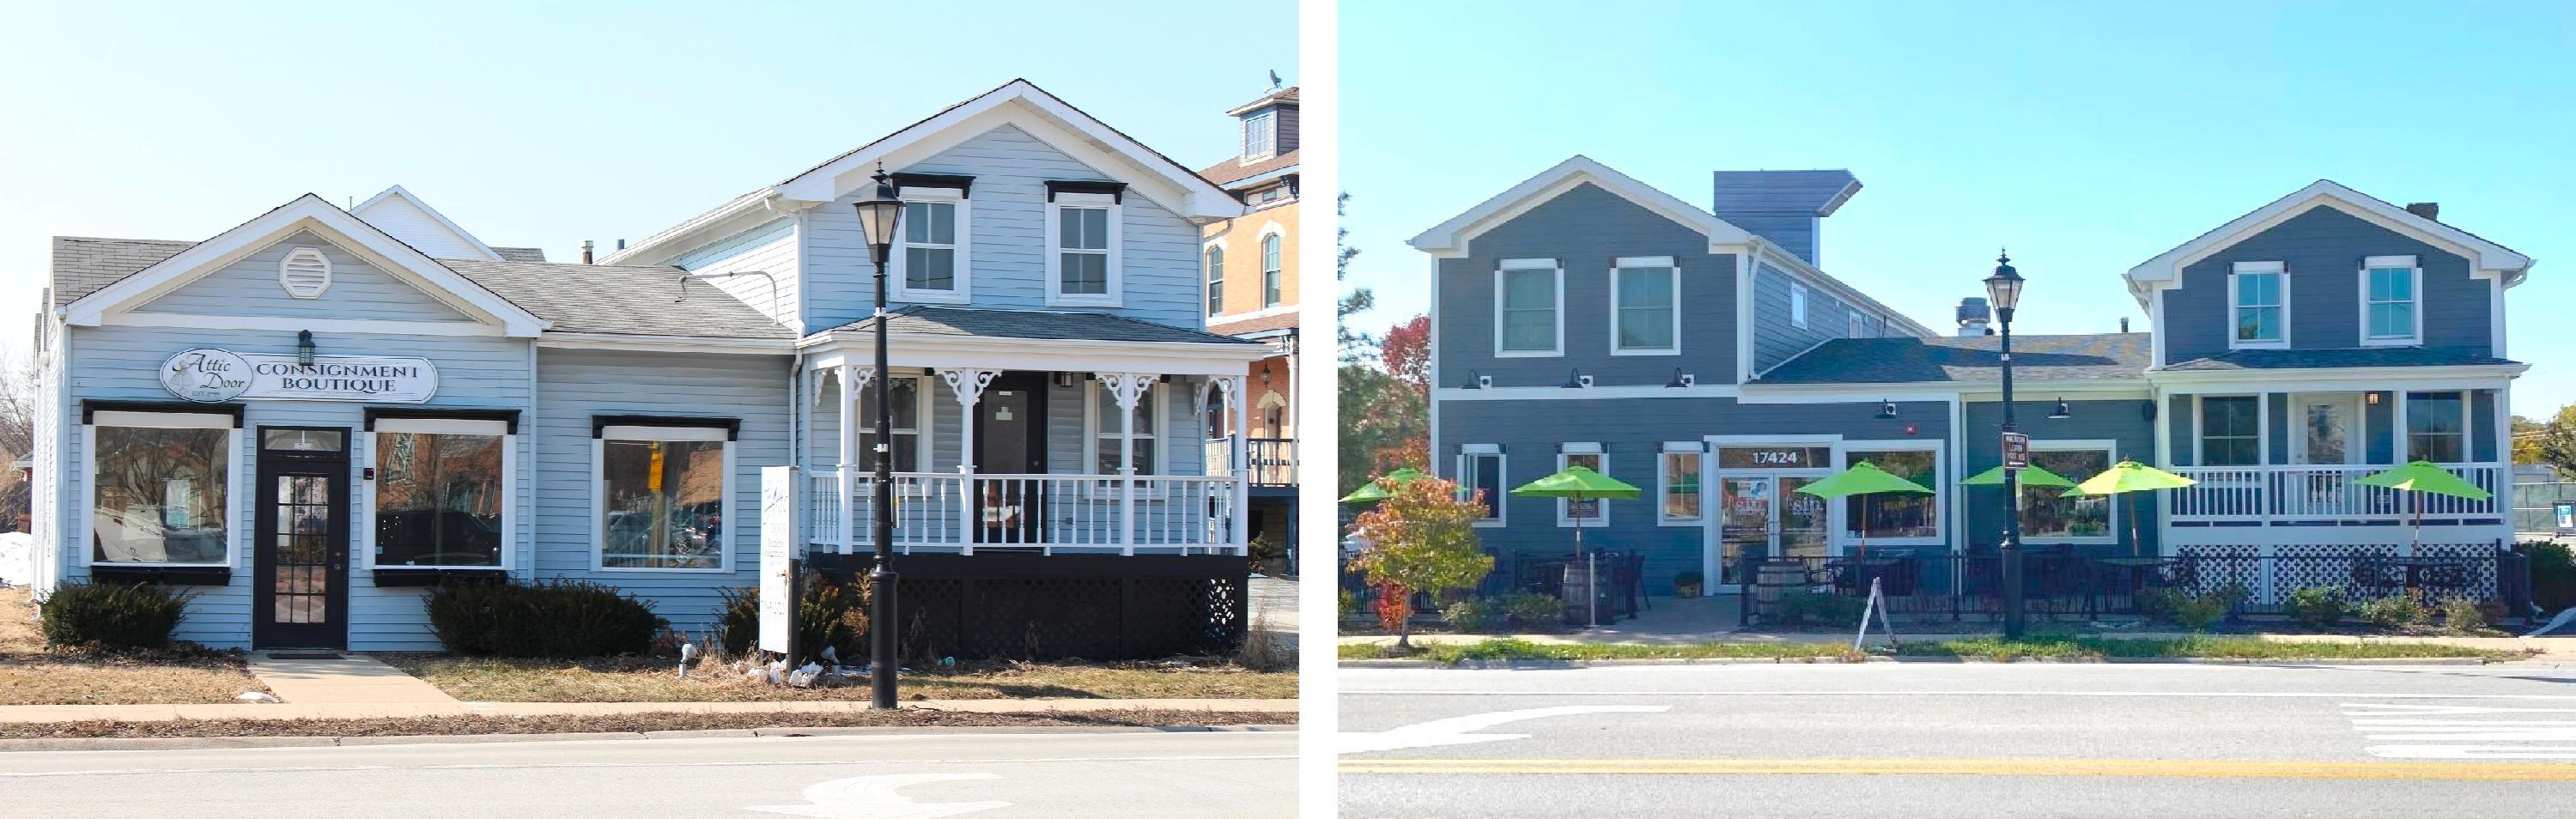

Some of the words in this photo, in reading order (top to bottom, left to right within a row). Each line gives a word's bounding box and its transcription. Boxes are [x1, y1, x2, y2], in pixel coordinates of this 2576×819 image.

[172, 353, 231, 373] Attic
[256, 363, 421, 379] CONSIGNMENT
[199, 372, 245, 390] Door
[282, 378, 396, 394] BOUTIQUE
[1753, 452, 1797, 464] 17424
